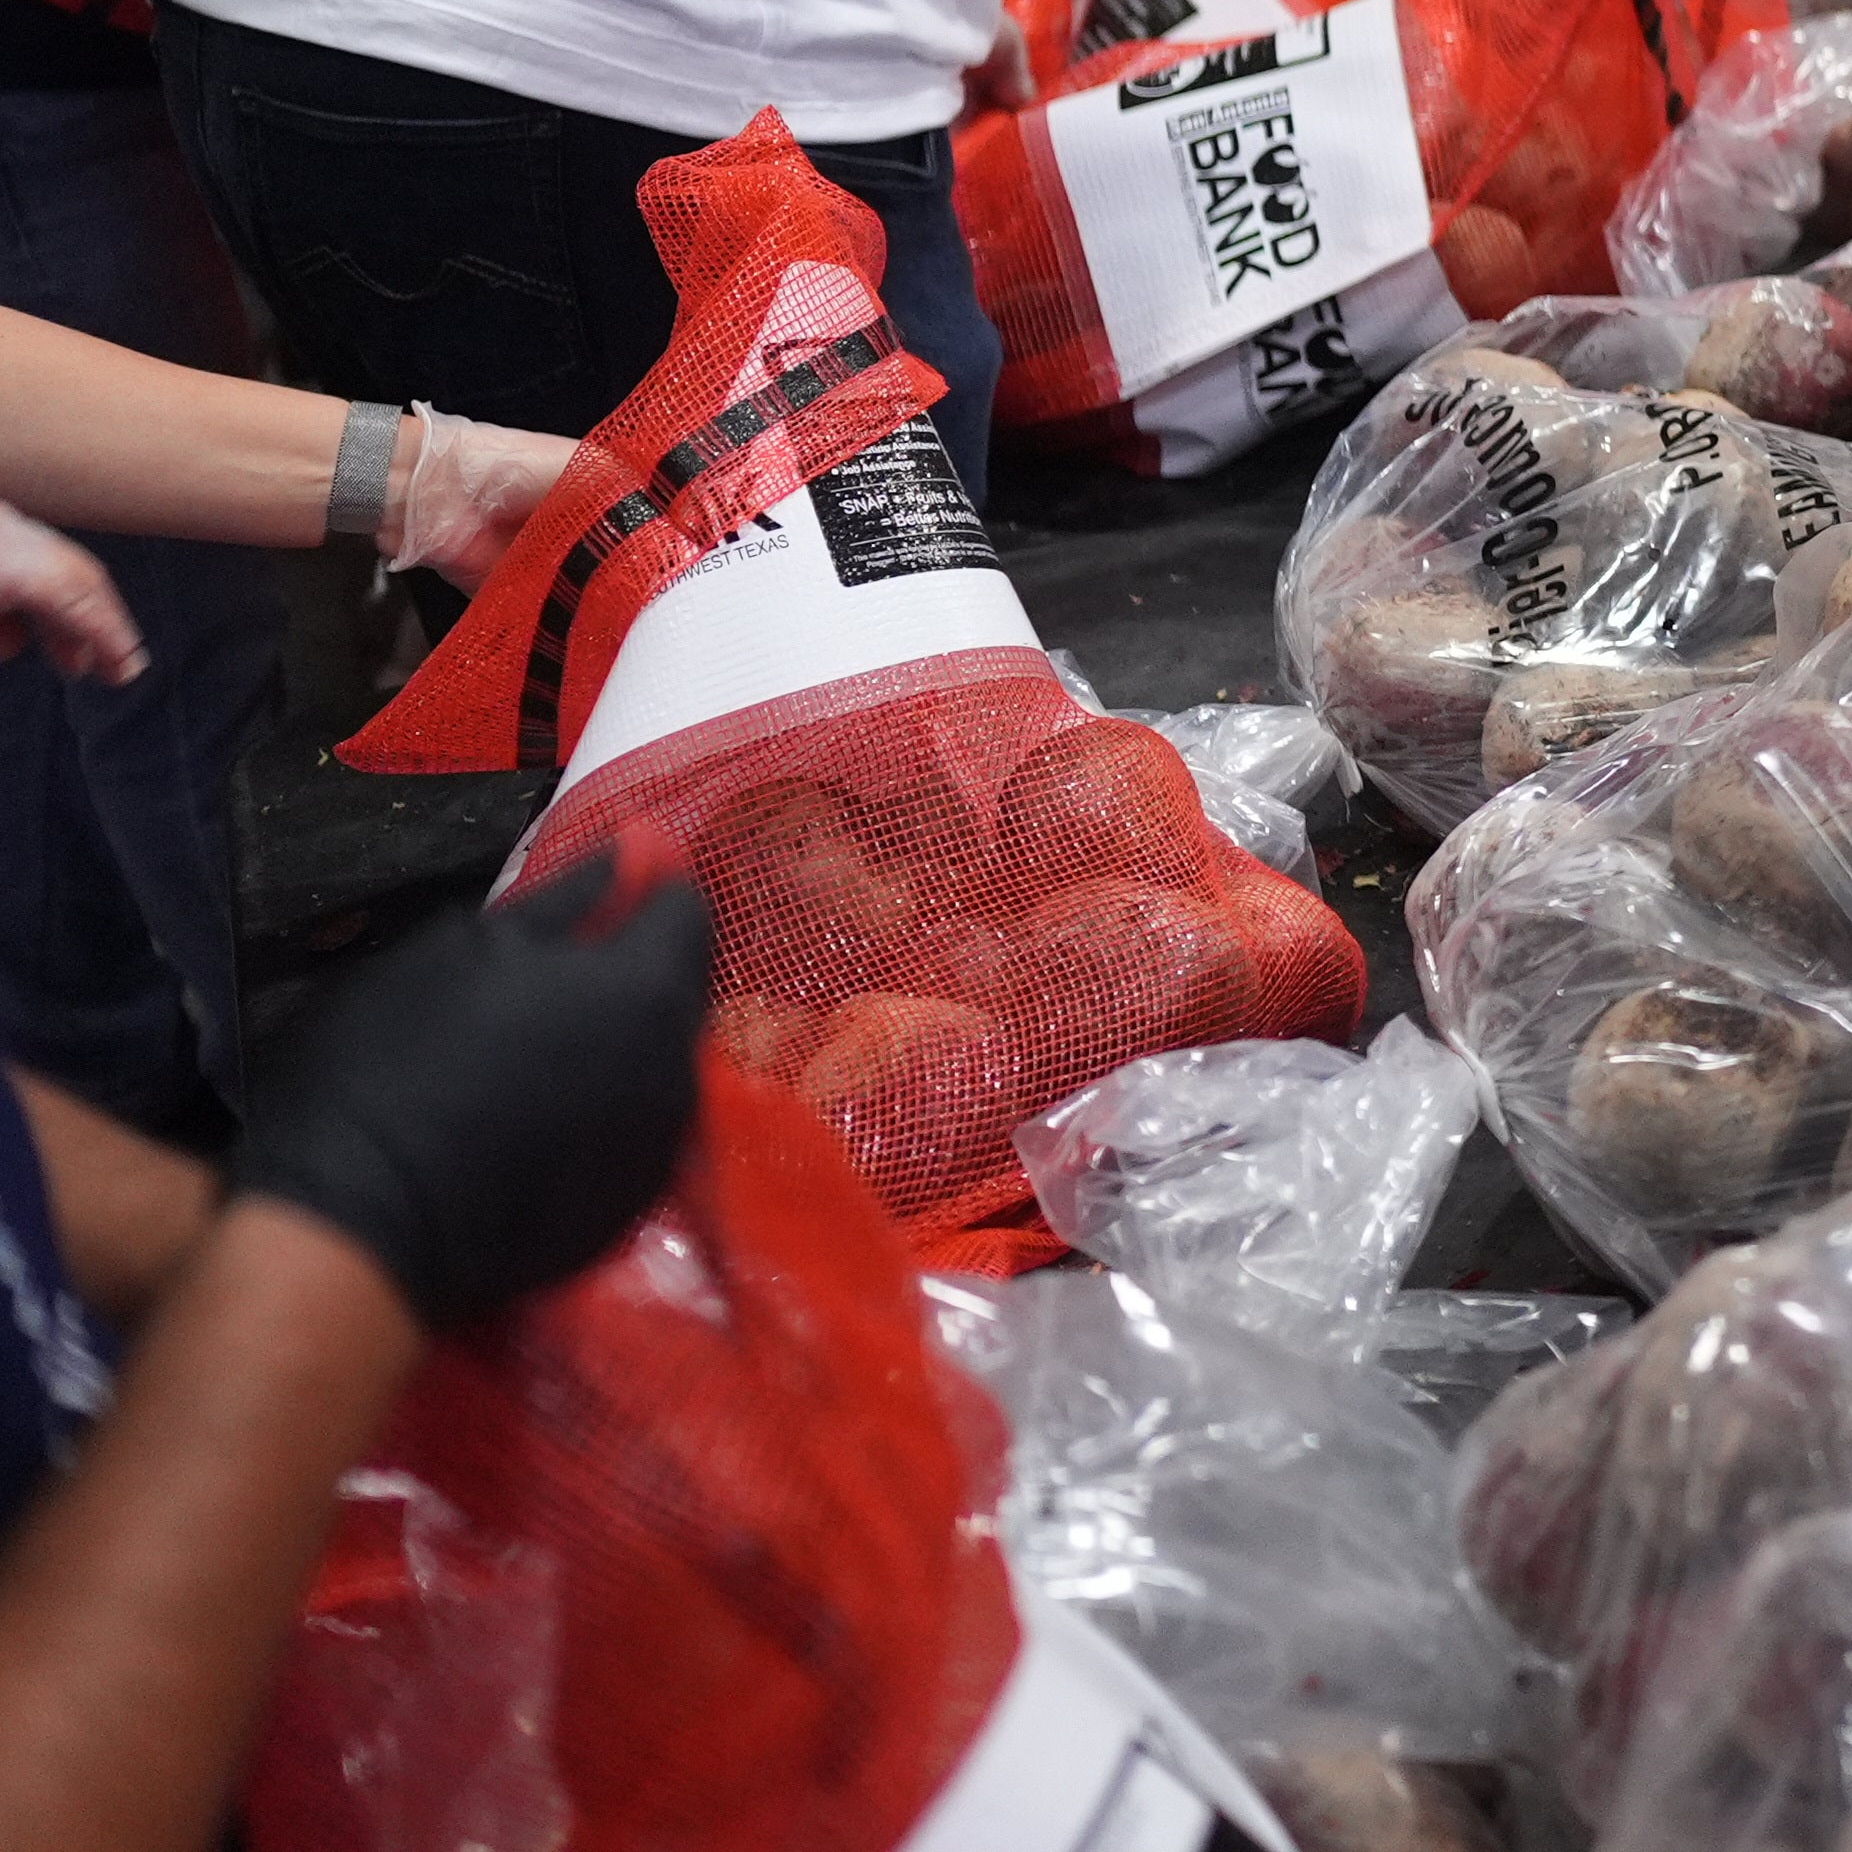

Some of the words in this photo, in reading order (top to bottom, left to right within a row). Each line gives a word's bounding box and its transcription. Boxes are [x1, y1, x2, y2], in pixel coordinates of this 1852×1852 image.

[1243, 113, 1321, 267] FOOD
[1188, 128, 1273, 301] BANK
[841, 463, 861, 476] Job
[842, 494, 890, 515] SNAP
[905, 491, 945, 507] Fruits
[893, 511, 939, 528] Better
[735, 533, 790, 561] TEXAS
